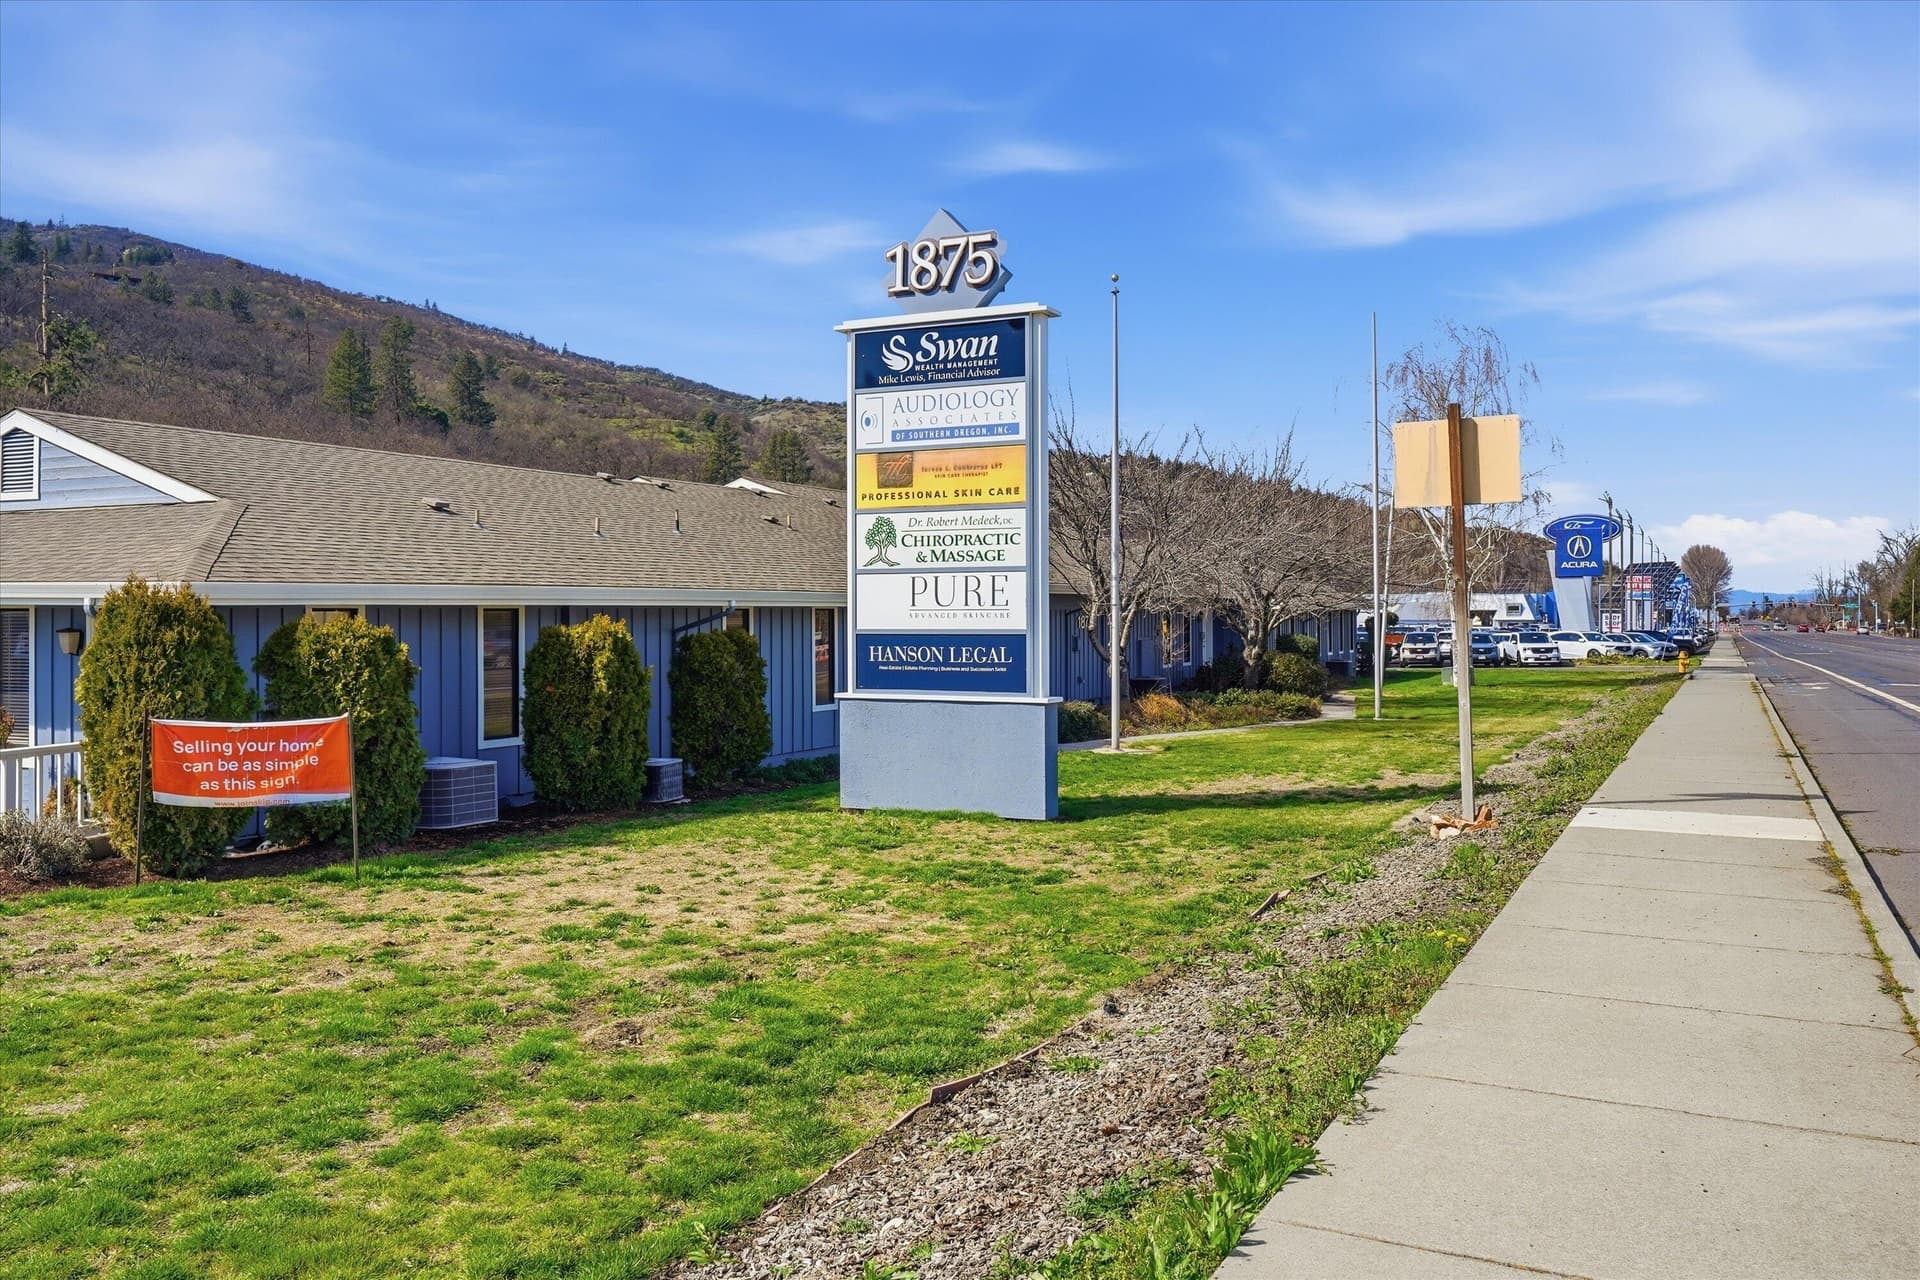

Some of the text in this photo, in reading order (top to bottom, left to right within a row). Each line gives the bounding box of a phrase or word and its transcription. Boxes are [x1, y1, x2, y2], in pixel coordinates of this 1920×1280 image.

[885, 230, 998, 297] 1875
[915, 331, 999, 363] Swan
[915, 358, 998, 372] WEALTH MANAGEMENT
[878, 367, 1001, 385] Mike Lewis, Financial Advisor
[893, 388, 1019, 414] AUDIOLOGY
[892, 410, 1017, 428] ASSOCIATES
[895, 425, 1012, 440] OF SOUTHERN OREGON, INC.
[861, 486, 1021, 501] PROFESSIONAL SKIN CARE
[908, 517, 924, 528] Dr.
[926, 516, 959, 528] Robert
[901, 532, 1022, 548] CHIROPRACTIC
[915, 549, 1006, 563] & MASSAGE
[1560, 561, 1599, 569] ACURA
[910, 574, 1010, 608] PURE
[962, 611, 1011, 619] SKINCARE
[868, 645, 1013, 664] HANSON LEGAL
[173, 738, 325, 756] Selling your home
[182, 754, 319, 773] can be as simple
[200, 774, 300, 791] as this sign.
